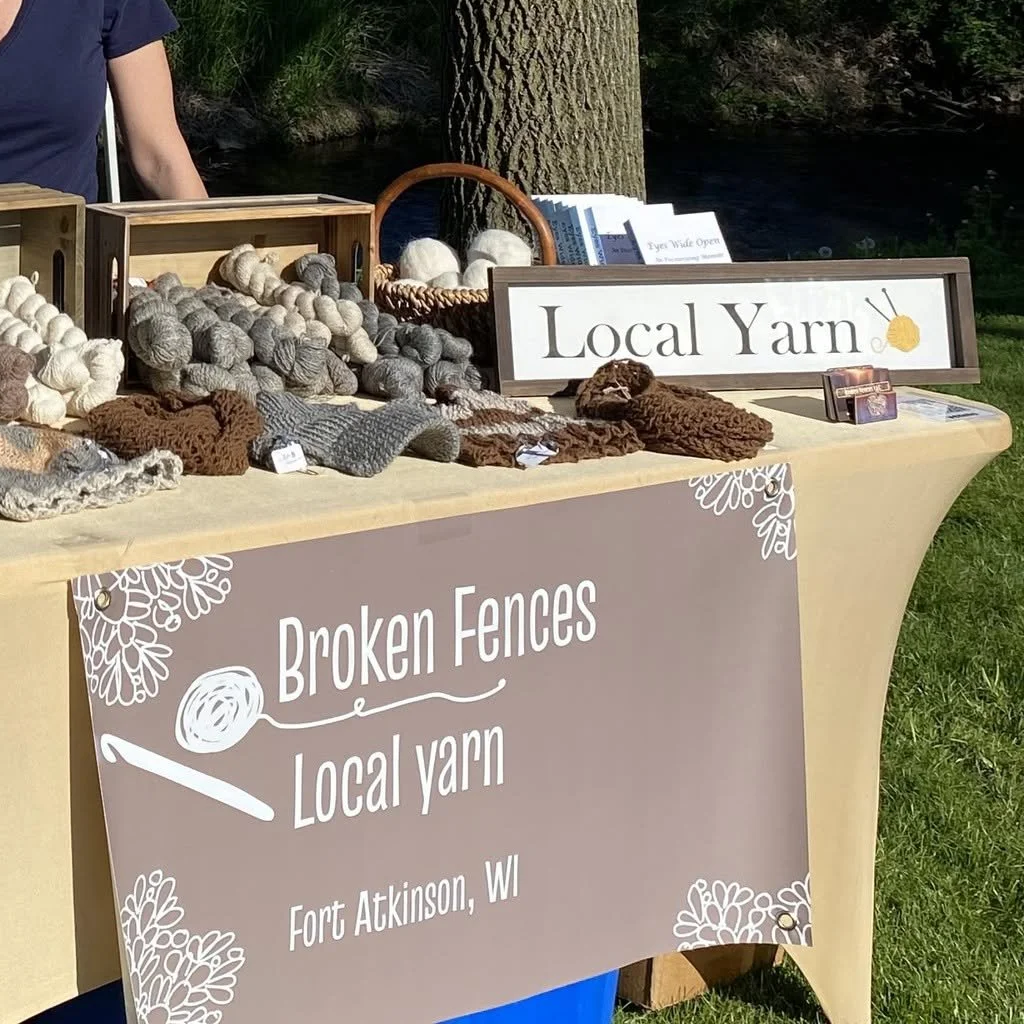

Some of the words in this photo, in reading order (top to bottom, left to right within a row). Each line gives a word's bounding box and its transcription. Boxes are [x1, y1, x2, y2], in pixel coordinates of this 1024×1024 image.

[647, 241, 668, 253] Eyes
[668, 237, 694, 249] Wide
[695, 237, 721, 249] Open
[539, 302, 702, 359] Local
[718, 302, 862, 355] Yarn
[278, 605, 435, 704] Broken
[453, 579, 598, 668] Fences
[293, 733, 402, 830] Local
[415, 725, 505, 815] yarn
[289, 900, 346, 952] Fort
[354, 874, 475, 937] Atkinson,
[484, 854, 520, 904] WI
